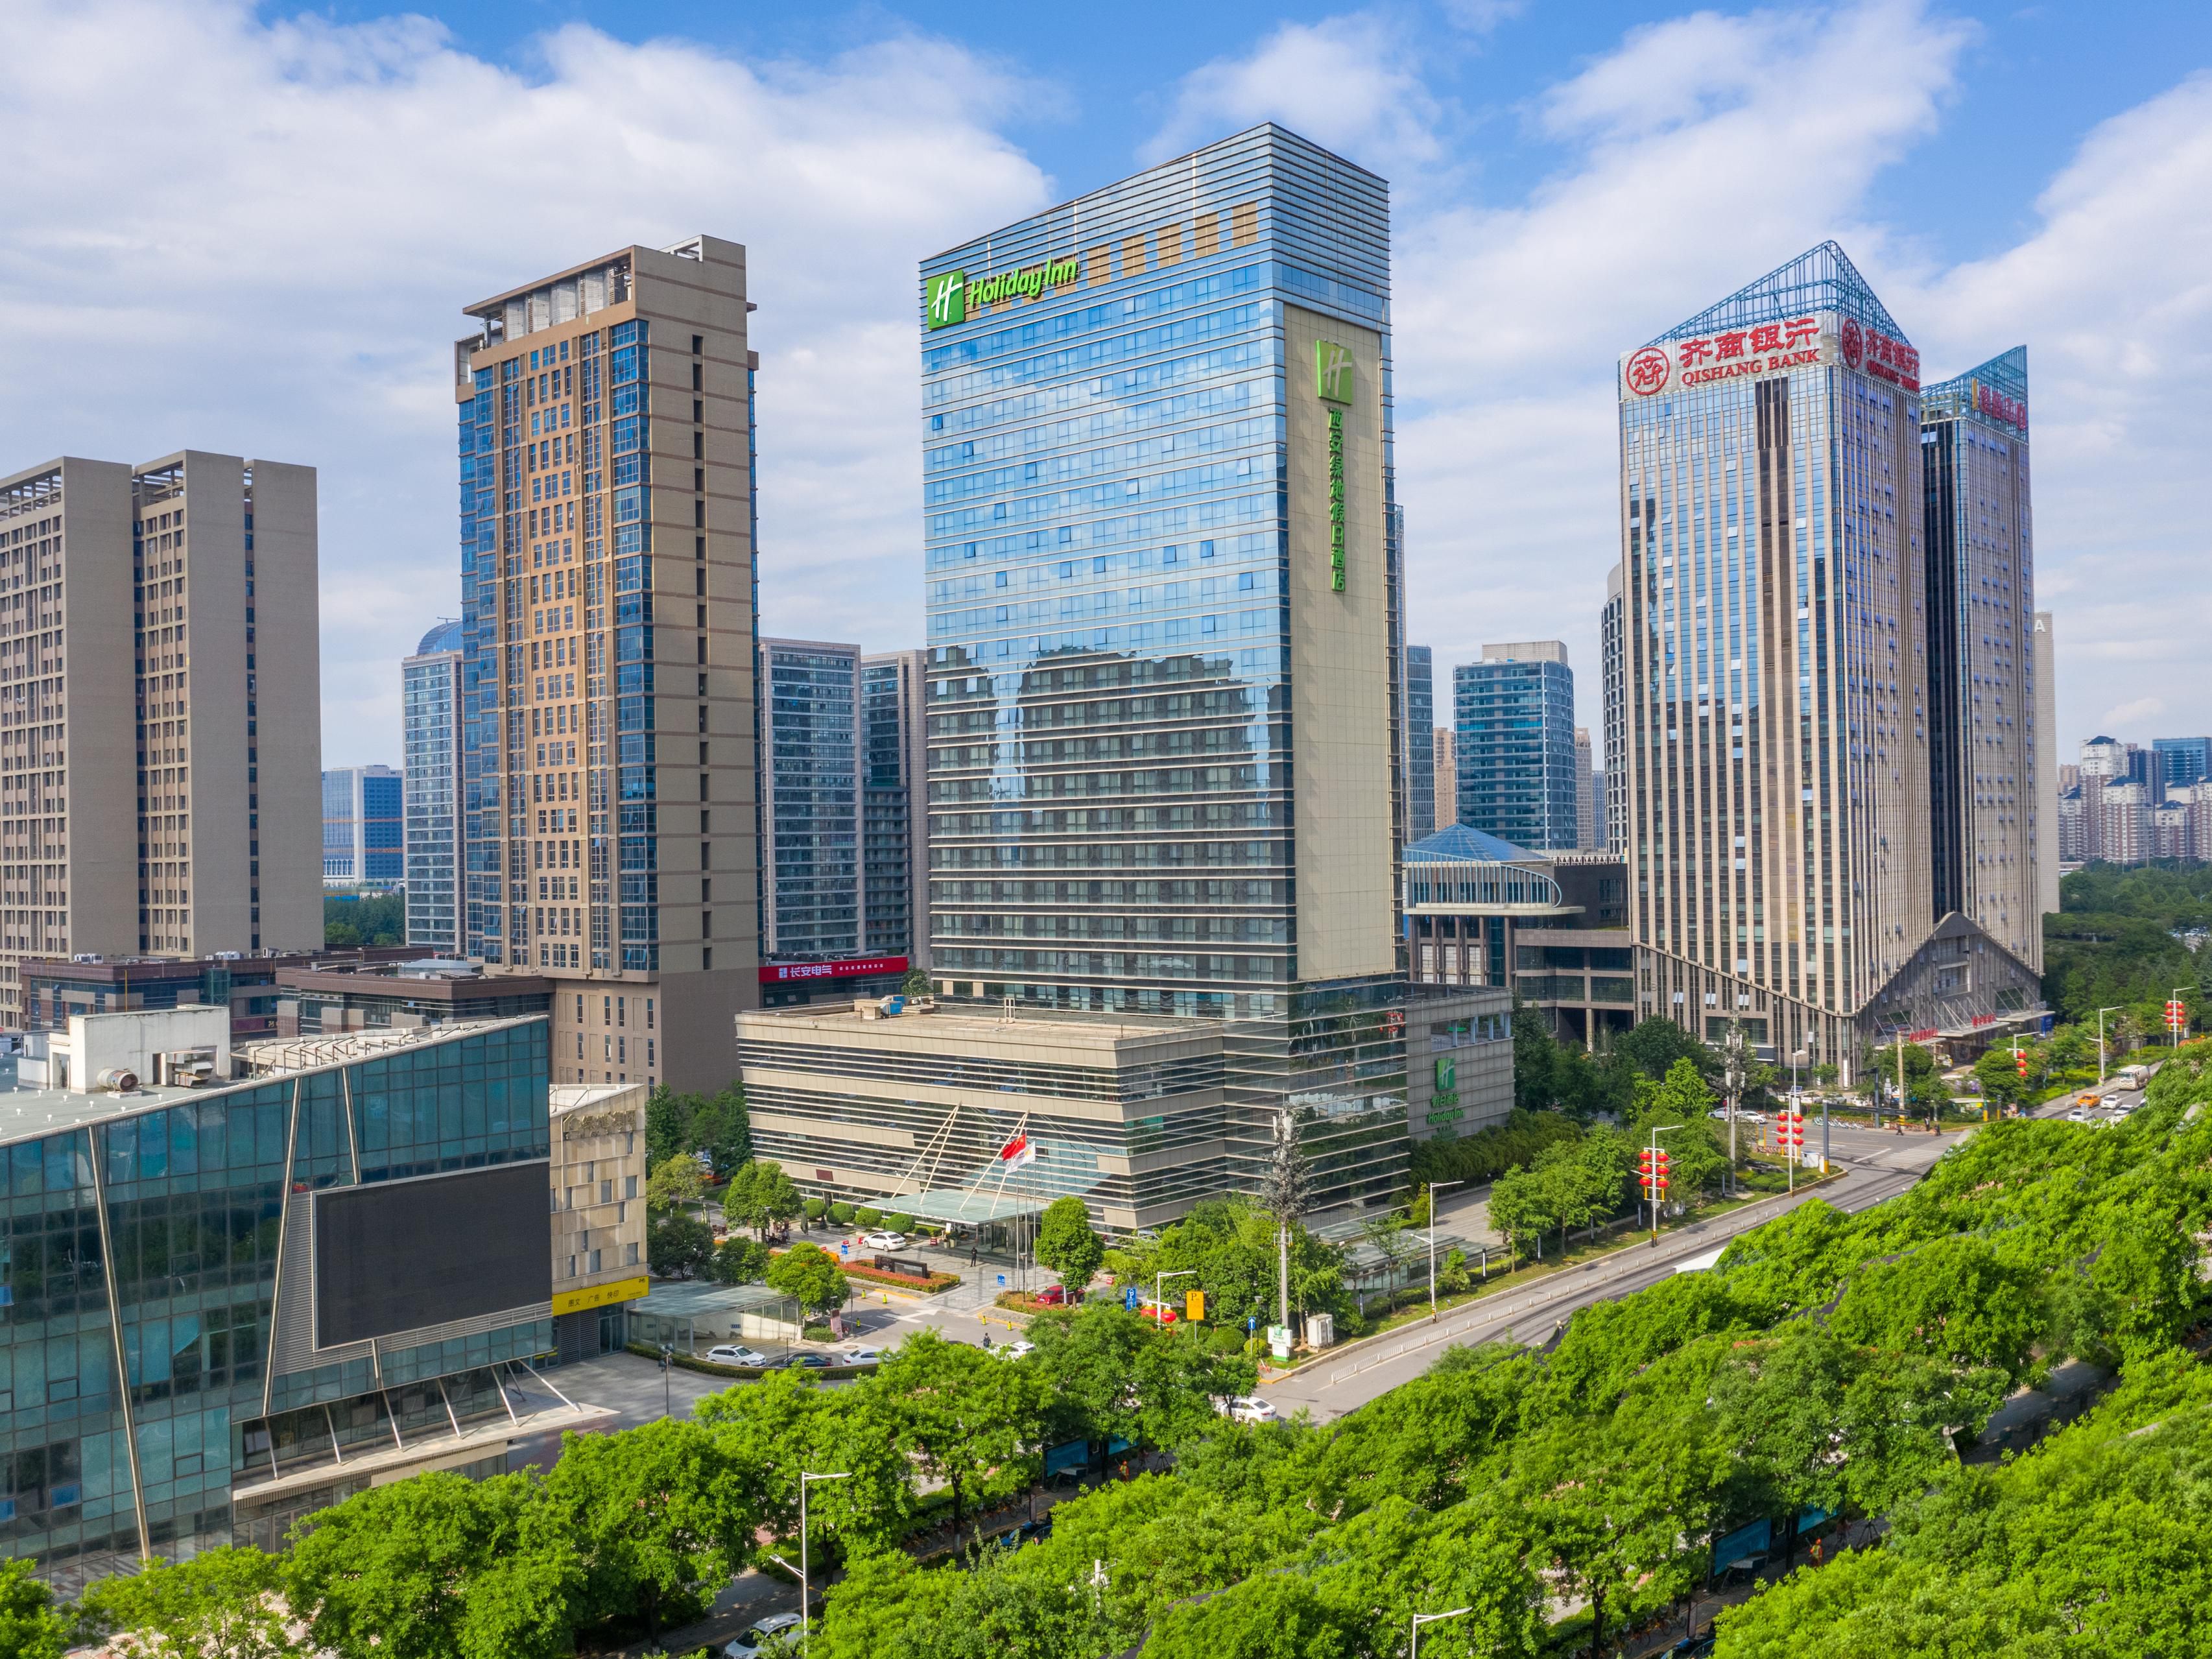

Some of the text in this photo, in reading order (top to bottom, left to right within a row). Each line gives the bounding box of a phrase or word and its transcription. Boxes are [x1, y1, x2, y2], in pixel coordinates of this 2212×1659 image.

[969, 258, 1078, 307] Holiday Inn
[1678, 317, 1820, 368] 齐商银行
[1682, 348, 1820, 387] QISHANG BANK
[1328, 409, 1346, 591] 西安绿地假日酒店
[790, 964, 832, 977] 长安电气
[1427, 1106, 1464, 1124] Holiday Inn
[587, 1294, 601, 1304] 广告
[607, 1289, 619, 1299] 快印
[1191, 1293, 1197, 1301] P
